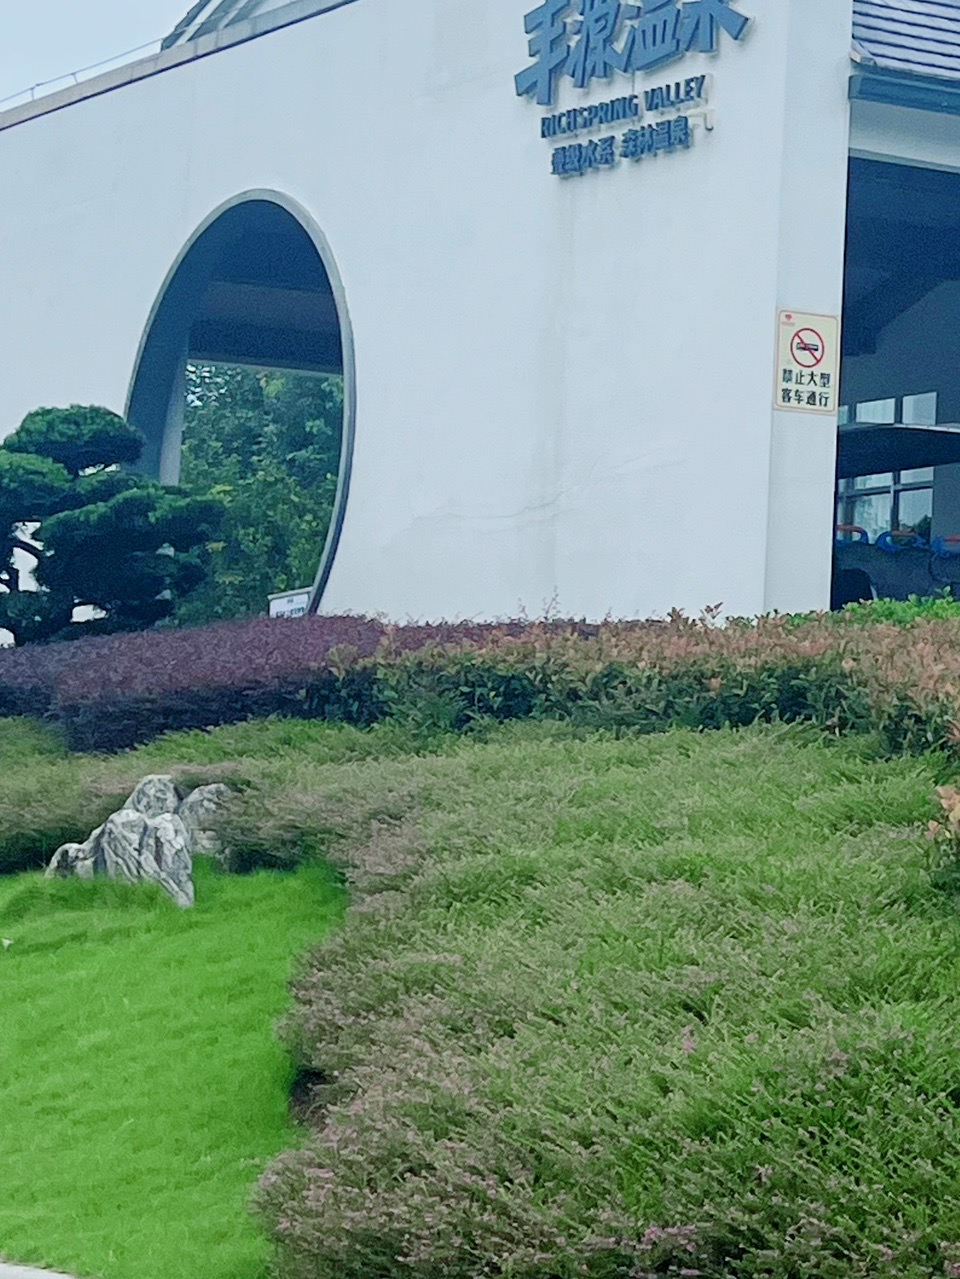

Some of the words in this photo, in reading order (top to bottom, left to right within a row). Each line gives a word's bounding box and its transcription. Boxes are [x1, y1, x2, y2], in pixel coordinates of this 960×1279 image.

[541, 94, 639, 138] RICHSPRING
[644, 75, 706, 111] VALLEY
[782, 368, 831, 389] 禁止大型
[781, 388, 830, 407] 客车通行
